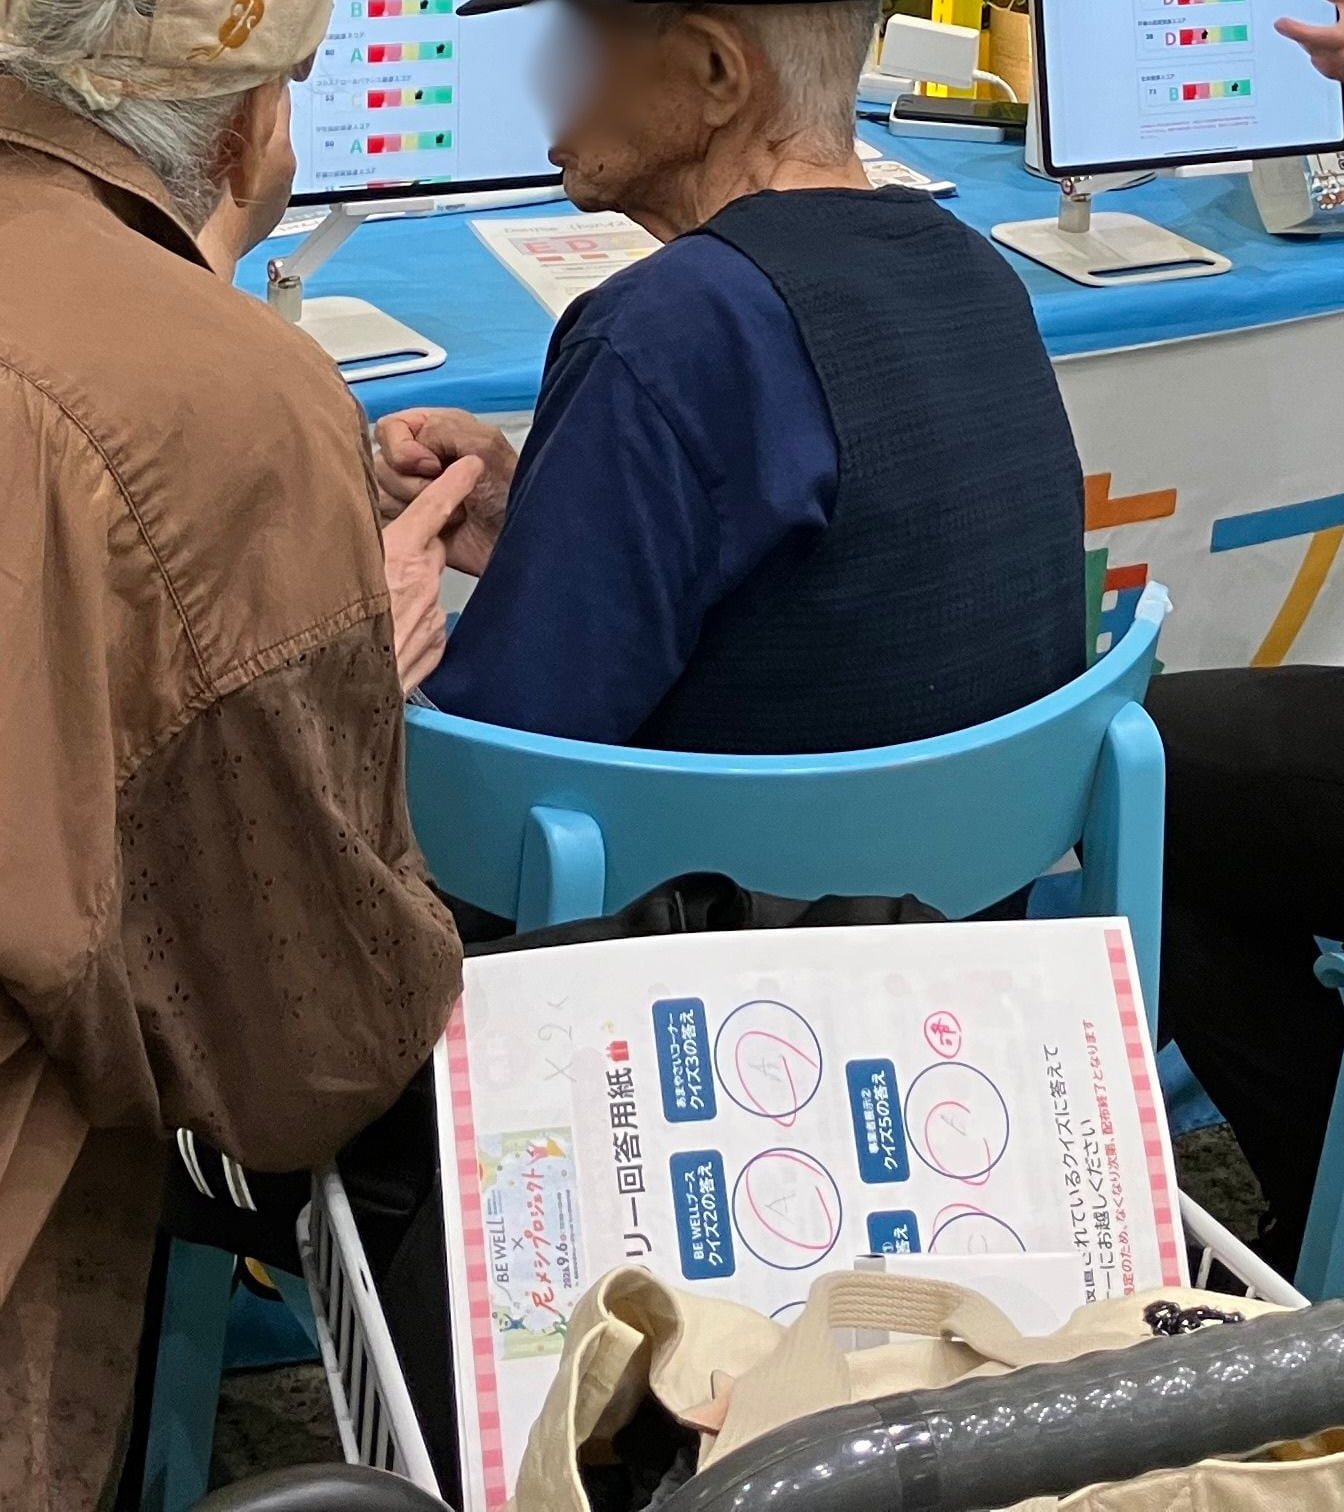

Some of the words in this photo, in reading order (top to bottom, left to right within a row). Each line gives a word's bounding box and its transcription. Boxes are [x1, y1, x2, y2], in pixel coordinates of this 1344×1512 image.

[351, 2, 362, 17] B
[1165, 32, 1176, 46] D
[351, 48, 363, 63] A
[1169, 87, 1179, 101] B
[350, 139, 362, 154] A
[680, 1008, 704, 1111] クイズ3の答え
[871, 1069, 898, 1170] クイズ5の答え
[606, 1067, 653, 1258] リー回答用紙
[696, 1161, 723, 1267] クイズ2の答え
[1081, 1119, 1116, 1300] ーにお越しください
[486, 1216, 507, 1259] WELL
[496, 1262, 509, 1283] BE
